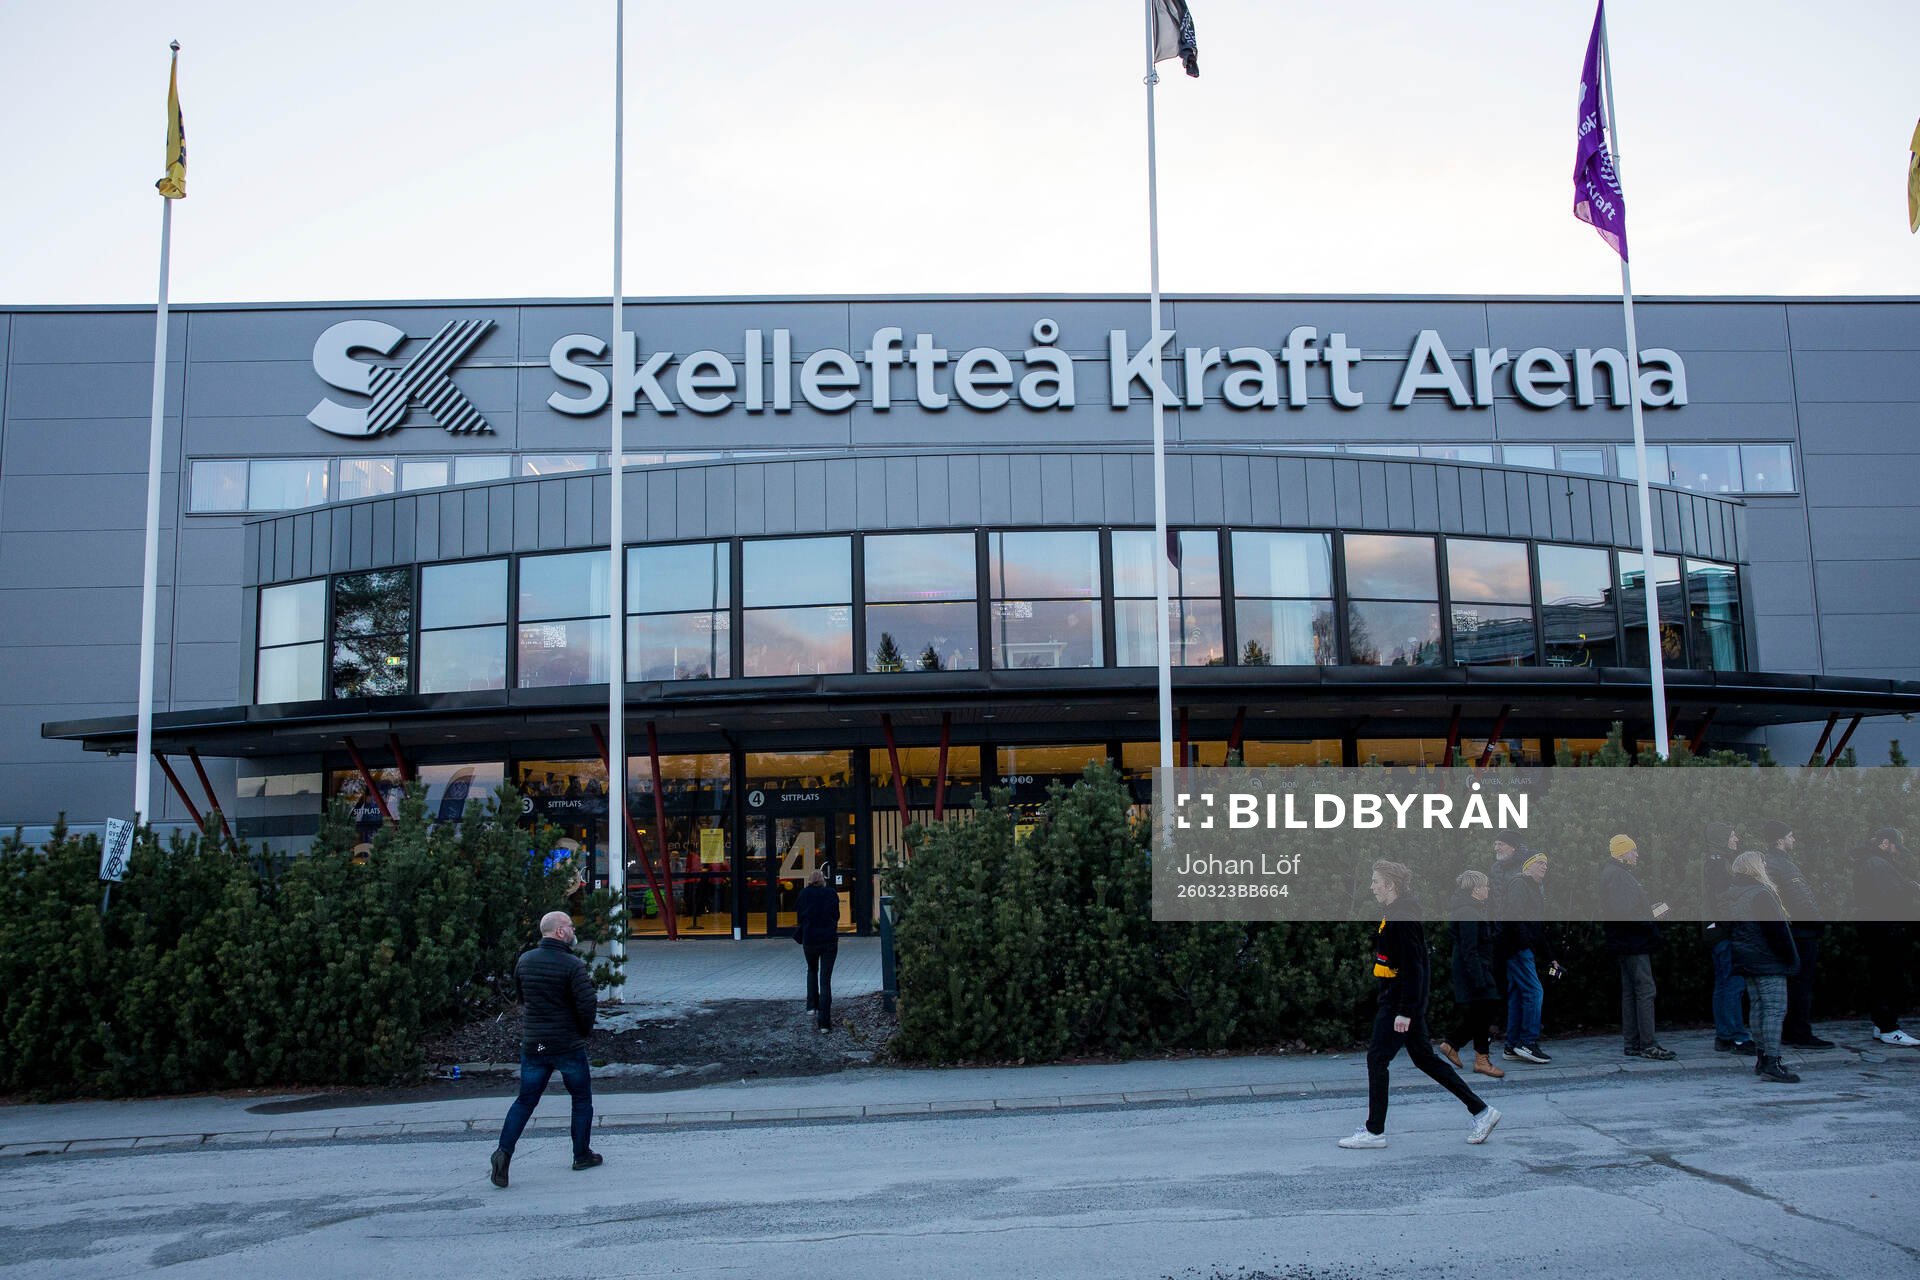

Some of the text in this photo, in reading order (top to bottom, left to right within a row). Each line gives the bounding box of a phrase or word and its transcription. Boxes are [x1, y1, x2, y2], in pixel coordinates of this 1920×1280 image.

[547, 318, 1688, 414] Skellefteå Kraft Arena
[547, 800, 582, 808] SITTPLATS
[751, 792, 820, 806] 4 SITTPLATS
[353, 807, 381, 816] SITTPLATS
[779, 831, 816, 888] 4
